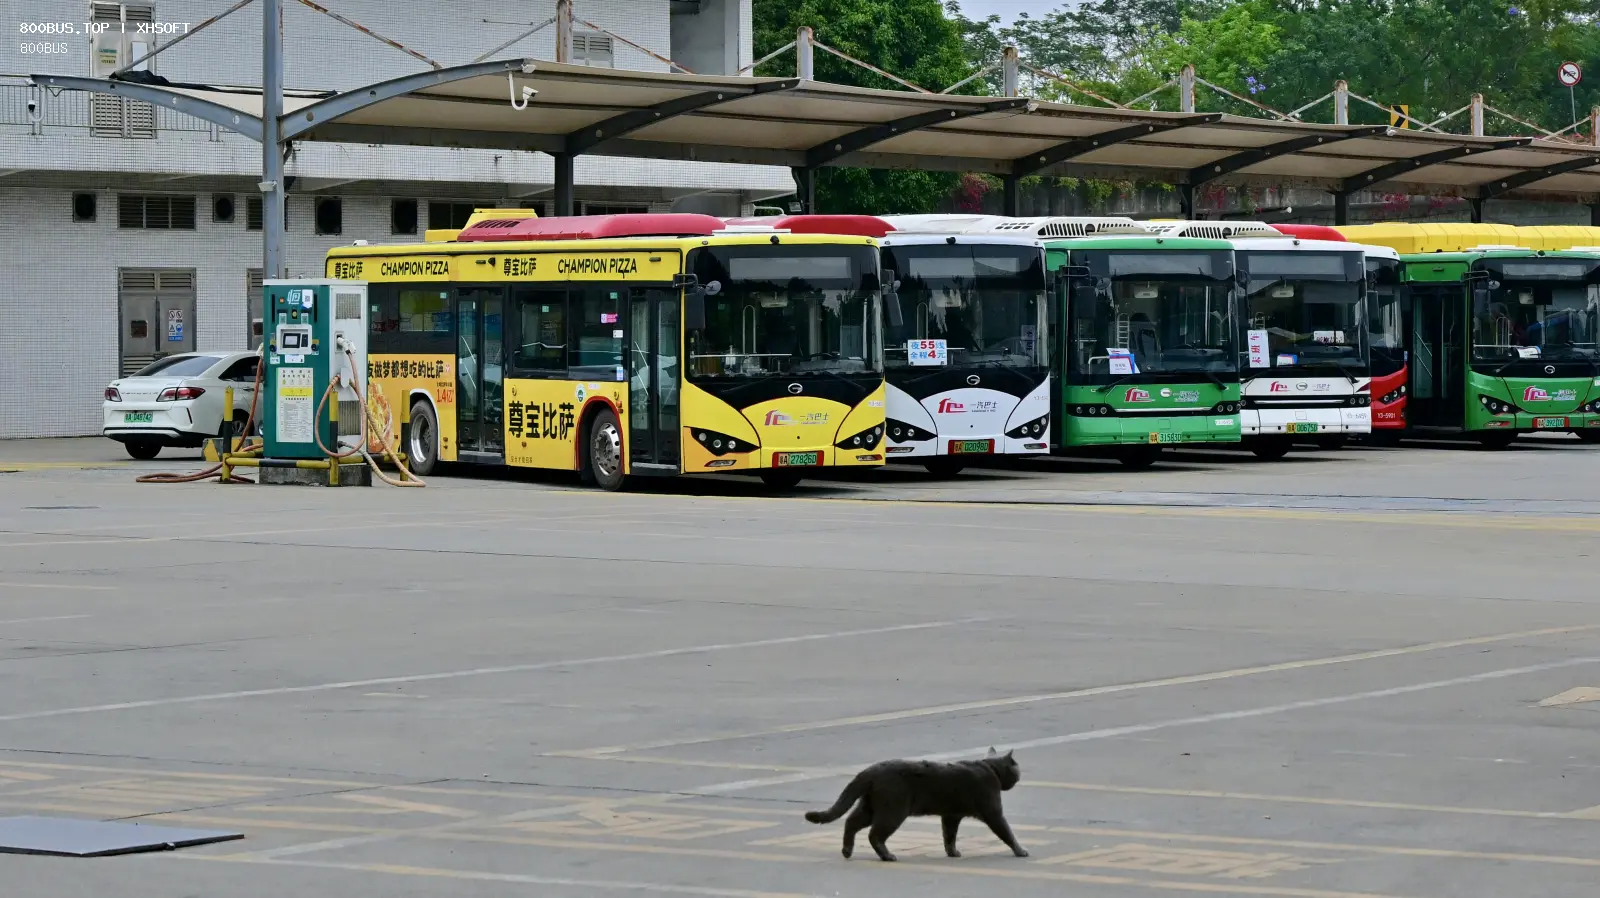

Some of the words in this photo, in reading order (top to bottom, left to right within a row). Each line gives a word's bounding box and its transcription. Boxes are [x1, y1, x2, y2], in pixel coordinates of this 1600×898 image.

[334, 261, 363, 279] 尊宝比萨
[381, 261, 425, 276] CHAMPION
[425, 260, 449, 275] PIZZA
[503, 257, 537, 276] 尊宝比萨
[557, 258, 607, 274] CHAMPION
[609, 258, 638, 274] PIZZA
[910, 350, 946, 359] 全程4元
[508, 400, 575, 440] 尊宝比萨
